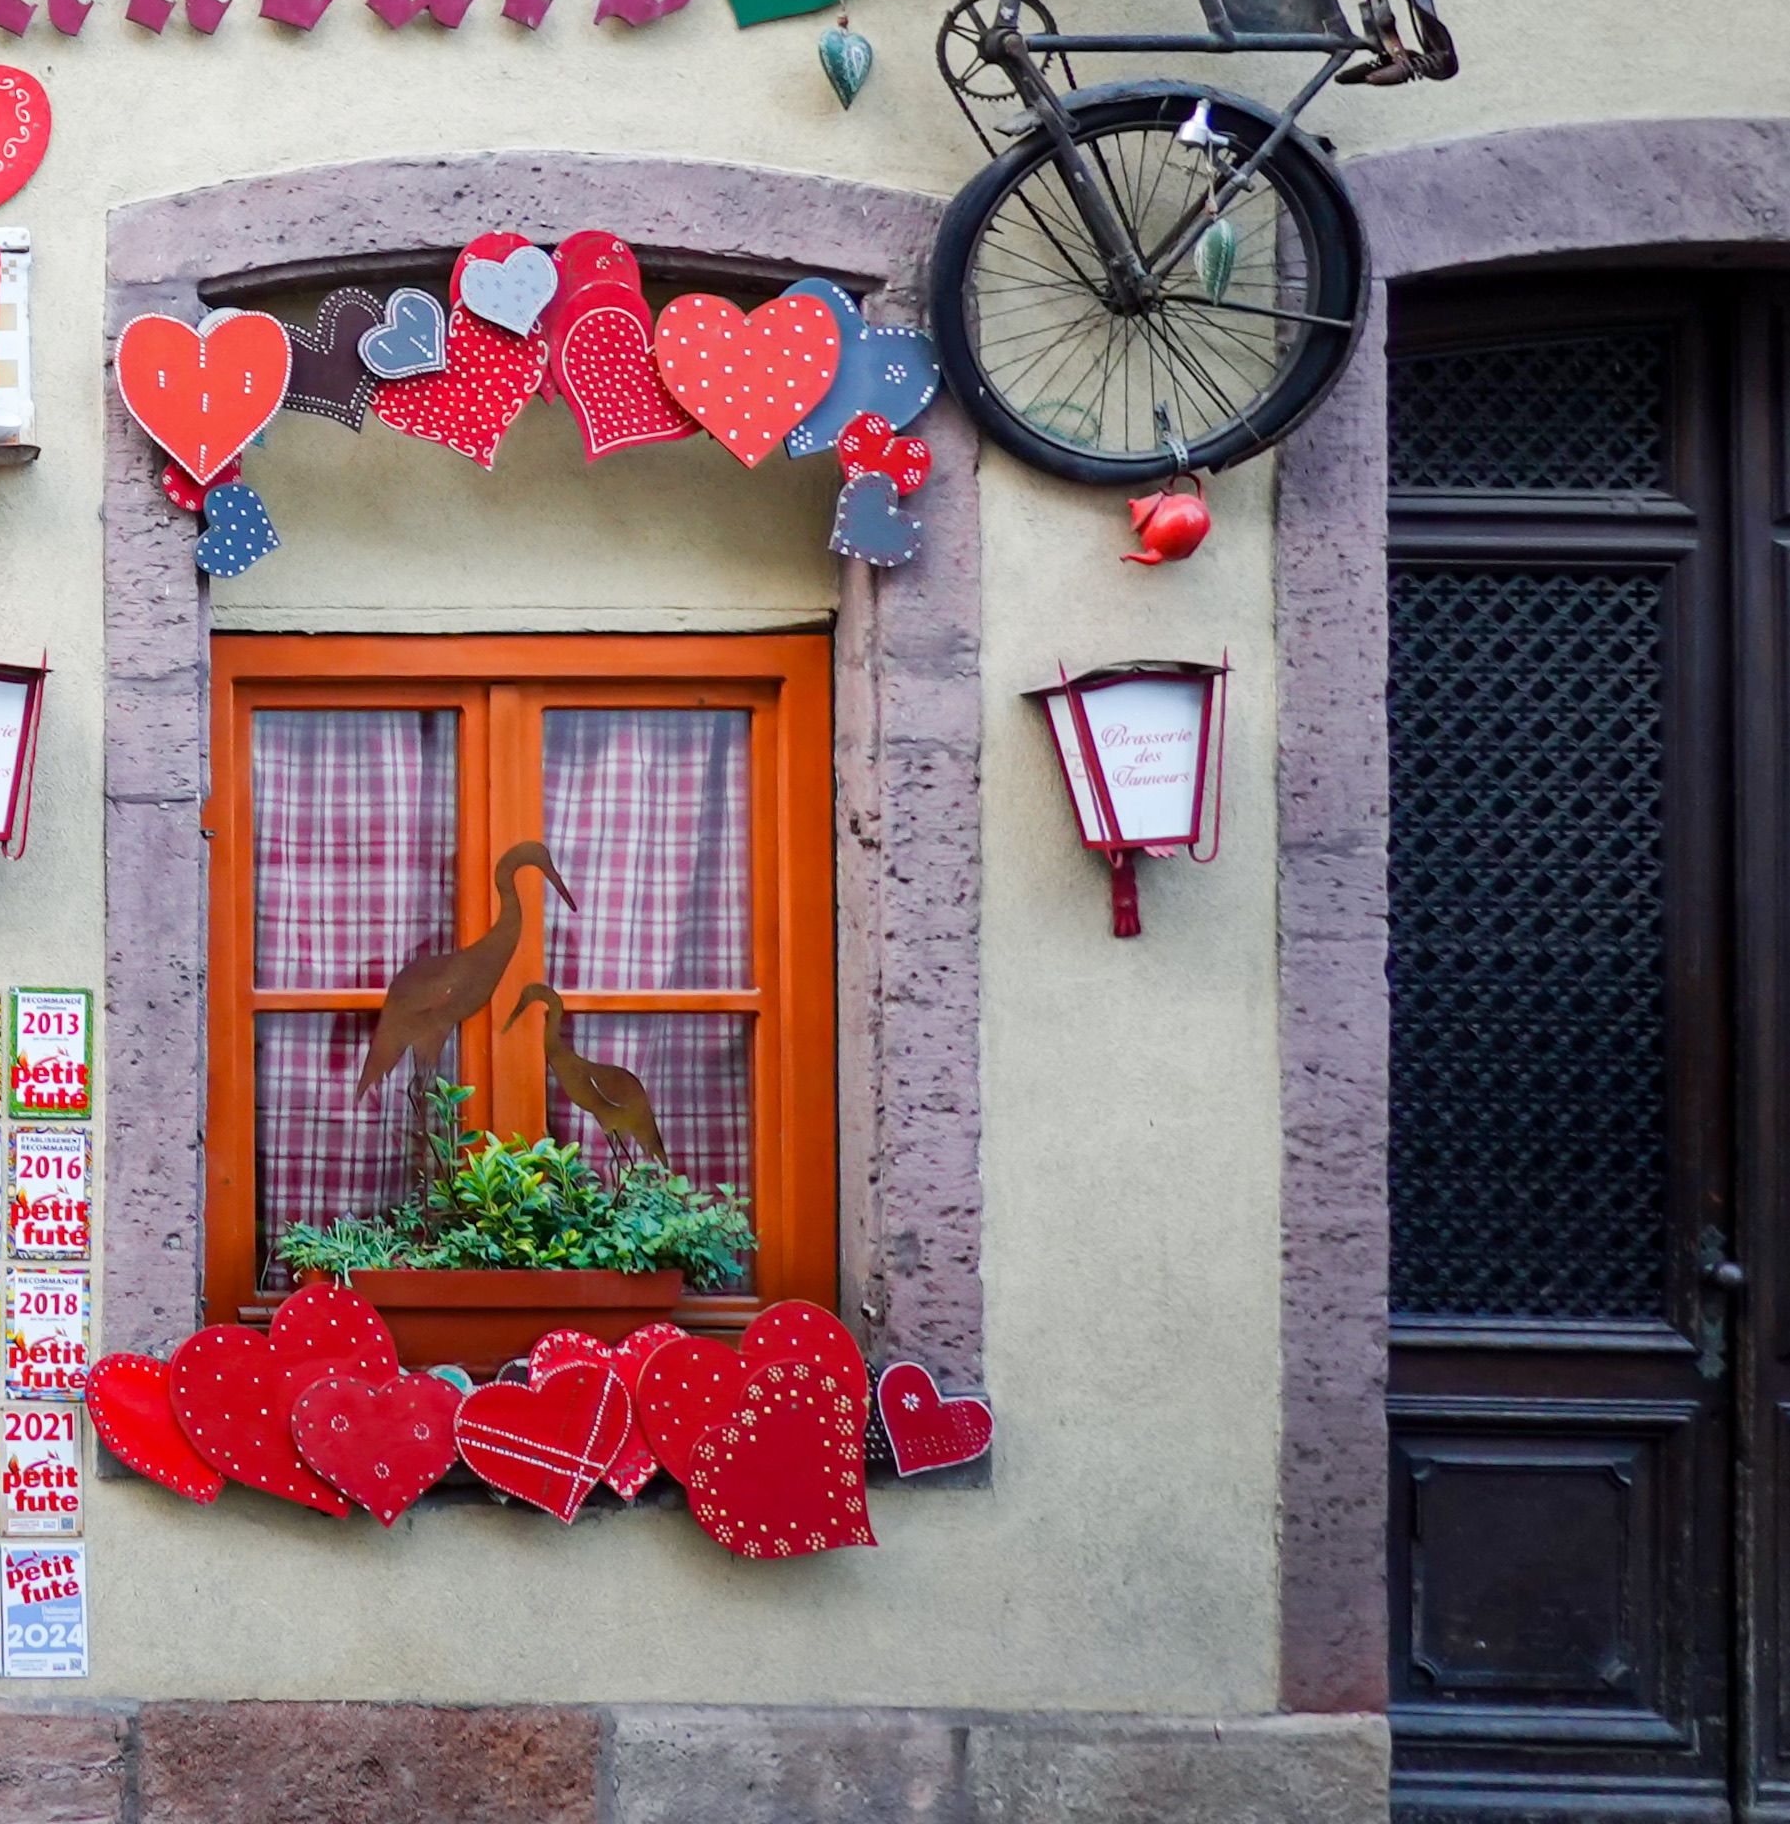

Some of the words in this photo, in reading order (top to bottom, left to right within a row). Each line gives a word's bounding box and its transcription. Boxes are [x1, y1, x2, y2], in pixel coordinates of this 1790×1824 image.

[1101, 723, 1193, 749] Brasserie
[1134, 747, 1162, 763] des
[1111, 765, 1190, 788] Tanneurs
[22, 1012, 79, 1034] 2013
[11, 1061, 89, 1089] petit
[24, 1084, 88, 1109] futé
[21, 1144, 81, 1152] RECOMMANDÉ
[19, 1155, 81, 1179] 2016
[11, 1198, 88, 1228] petit
[23, 1222, 88, 1246] futé
[18, 1277, 79, 1285] RECOMMANDÉ
[19, 1292, 77, 1315] 2018
[9, 1341, 85, 1368] petit
[21, 1364, 86, 1388] futé
[5, 1412, 73, 1441] 2021
[3, 1464, 78, 1494] petit
[6, 1555, 74, 1589] petit
[21, 1576, 79, 1604] futé
[8, 1623, 83, 1648] 2024
